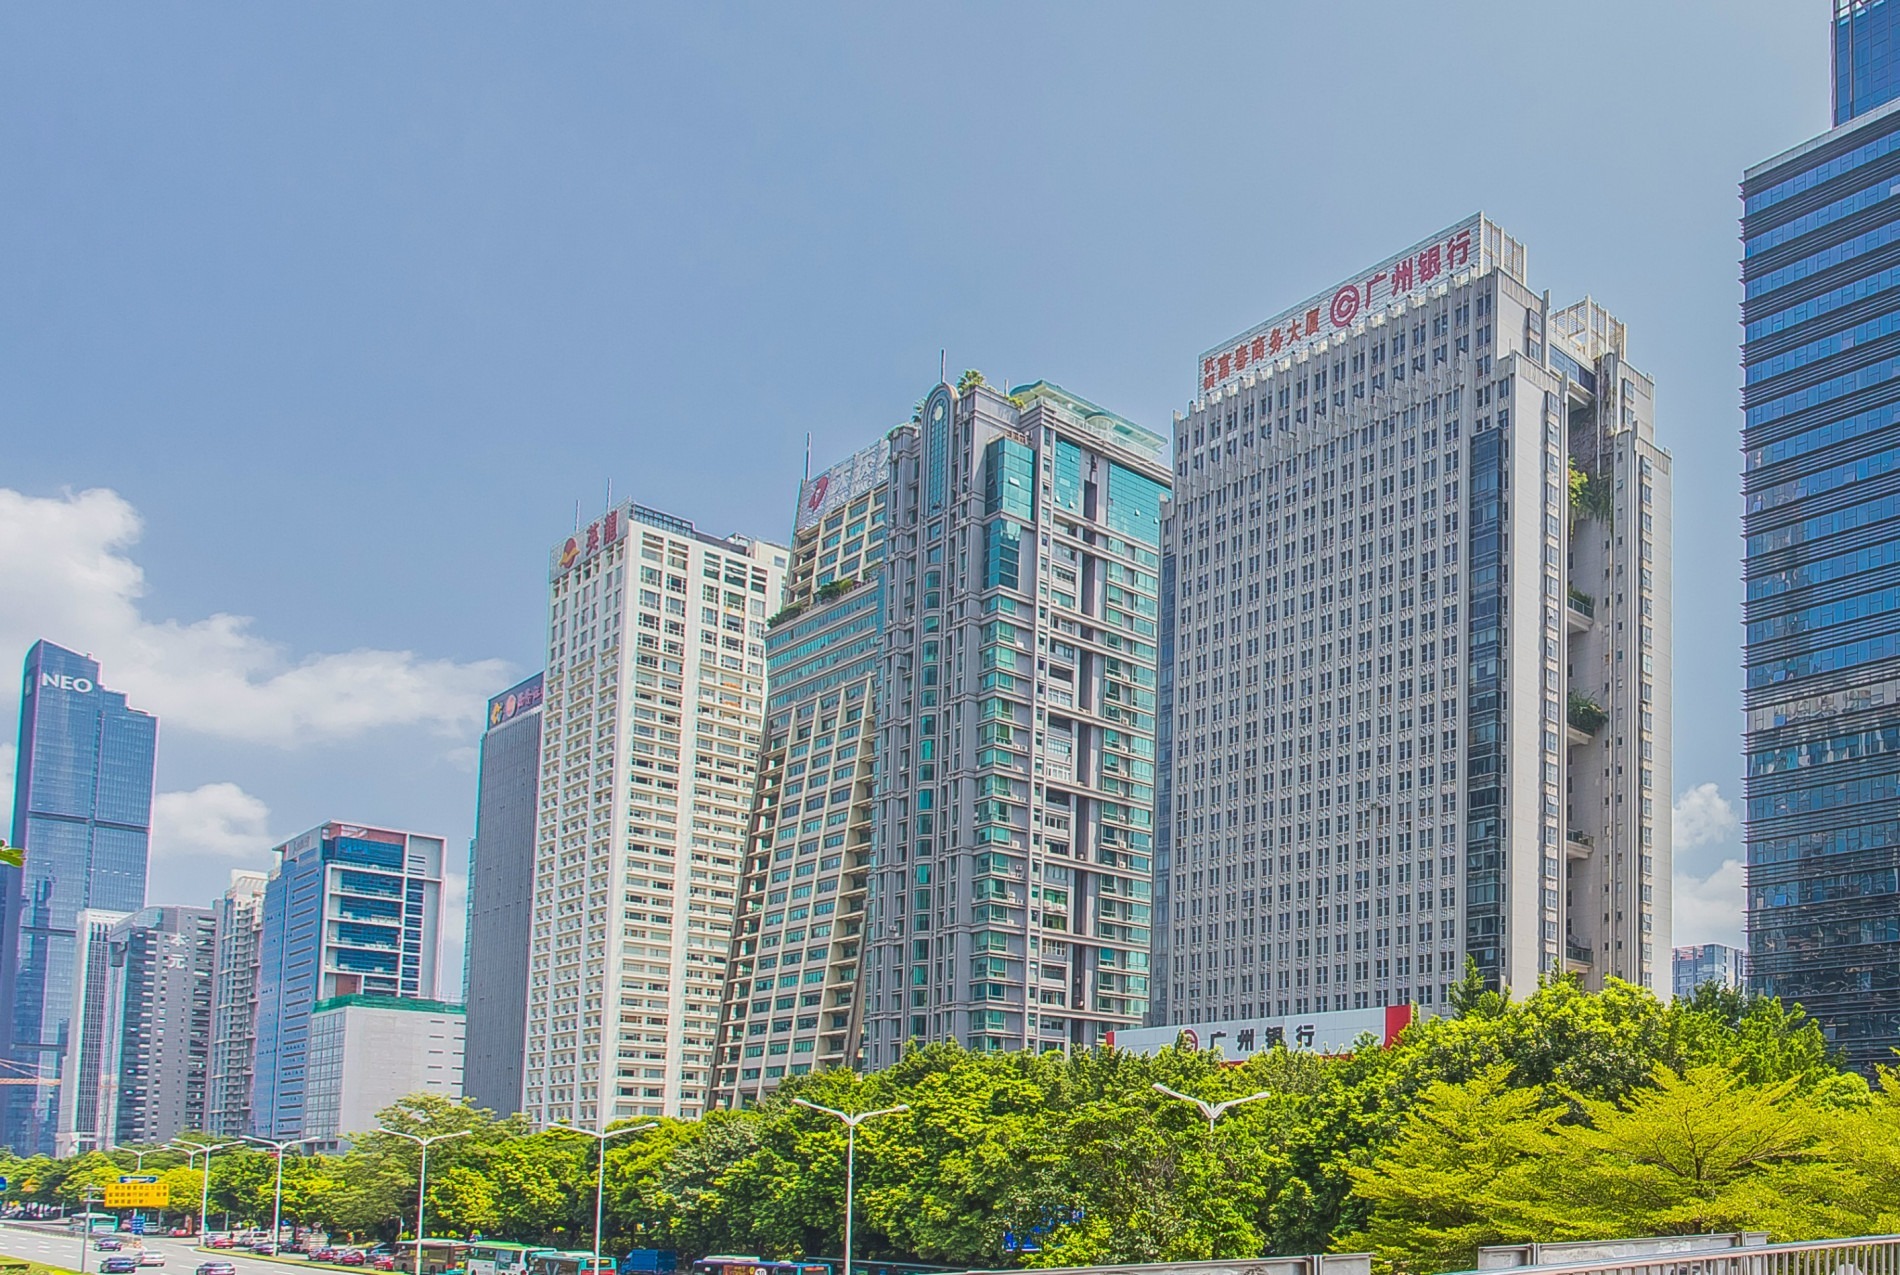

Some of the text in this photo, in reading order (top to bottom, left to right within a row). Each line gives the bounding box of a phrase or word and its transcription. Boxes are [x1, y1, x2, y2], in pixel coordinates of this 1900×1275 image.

[1365, 229, 1471, 309] 广州银行
[42, 672, 94, 693] NEO
[1210, 1025, 1315, 1051] 广州银行
